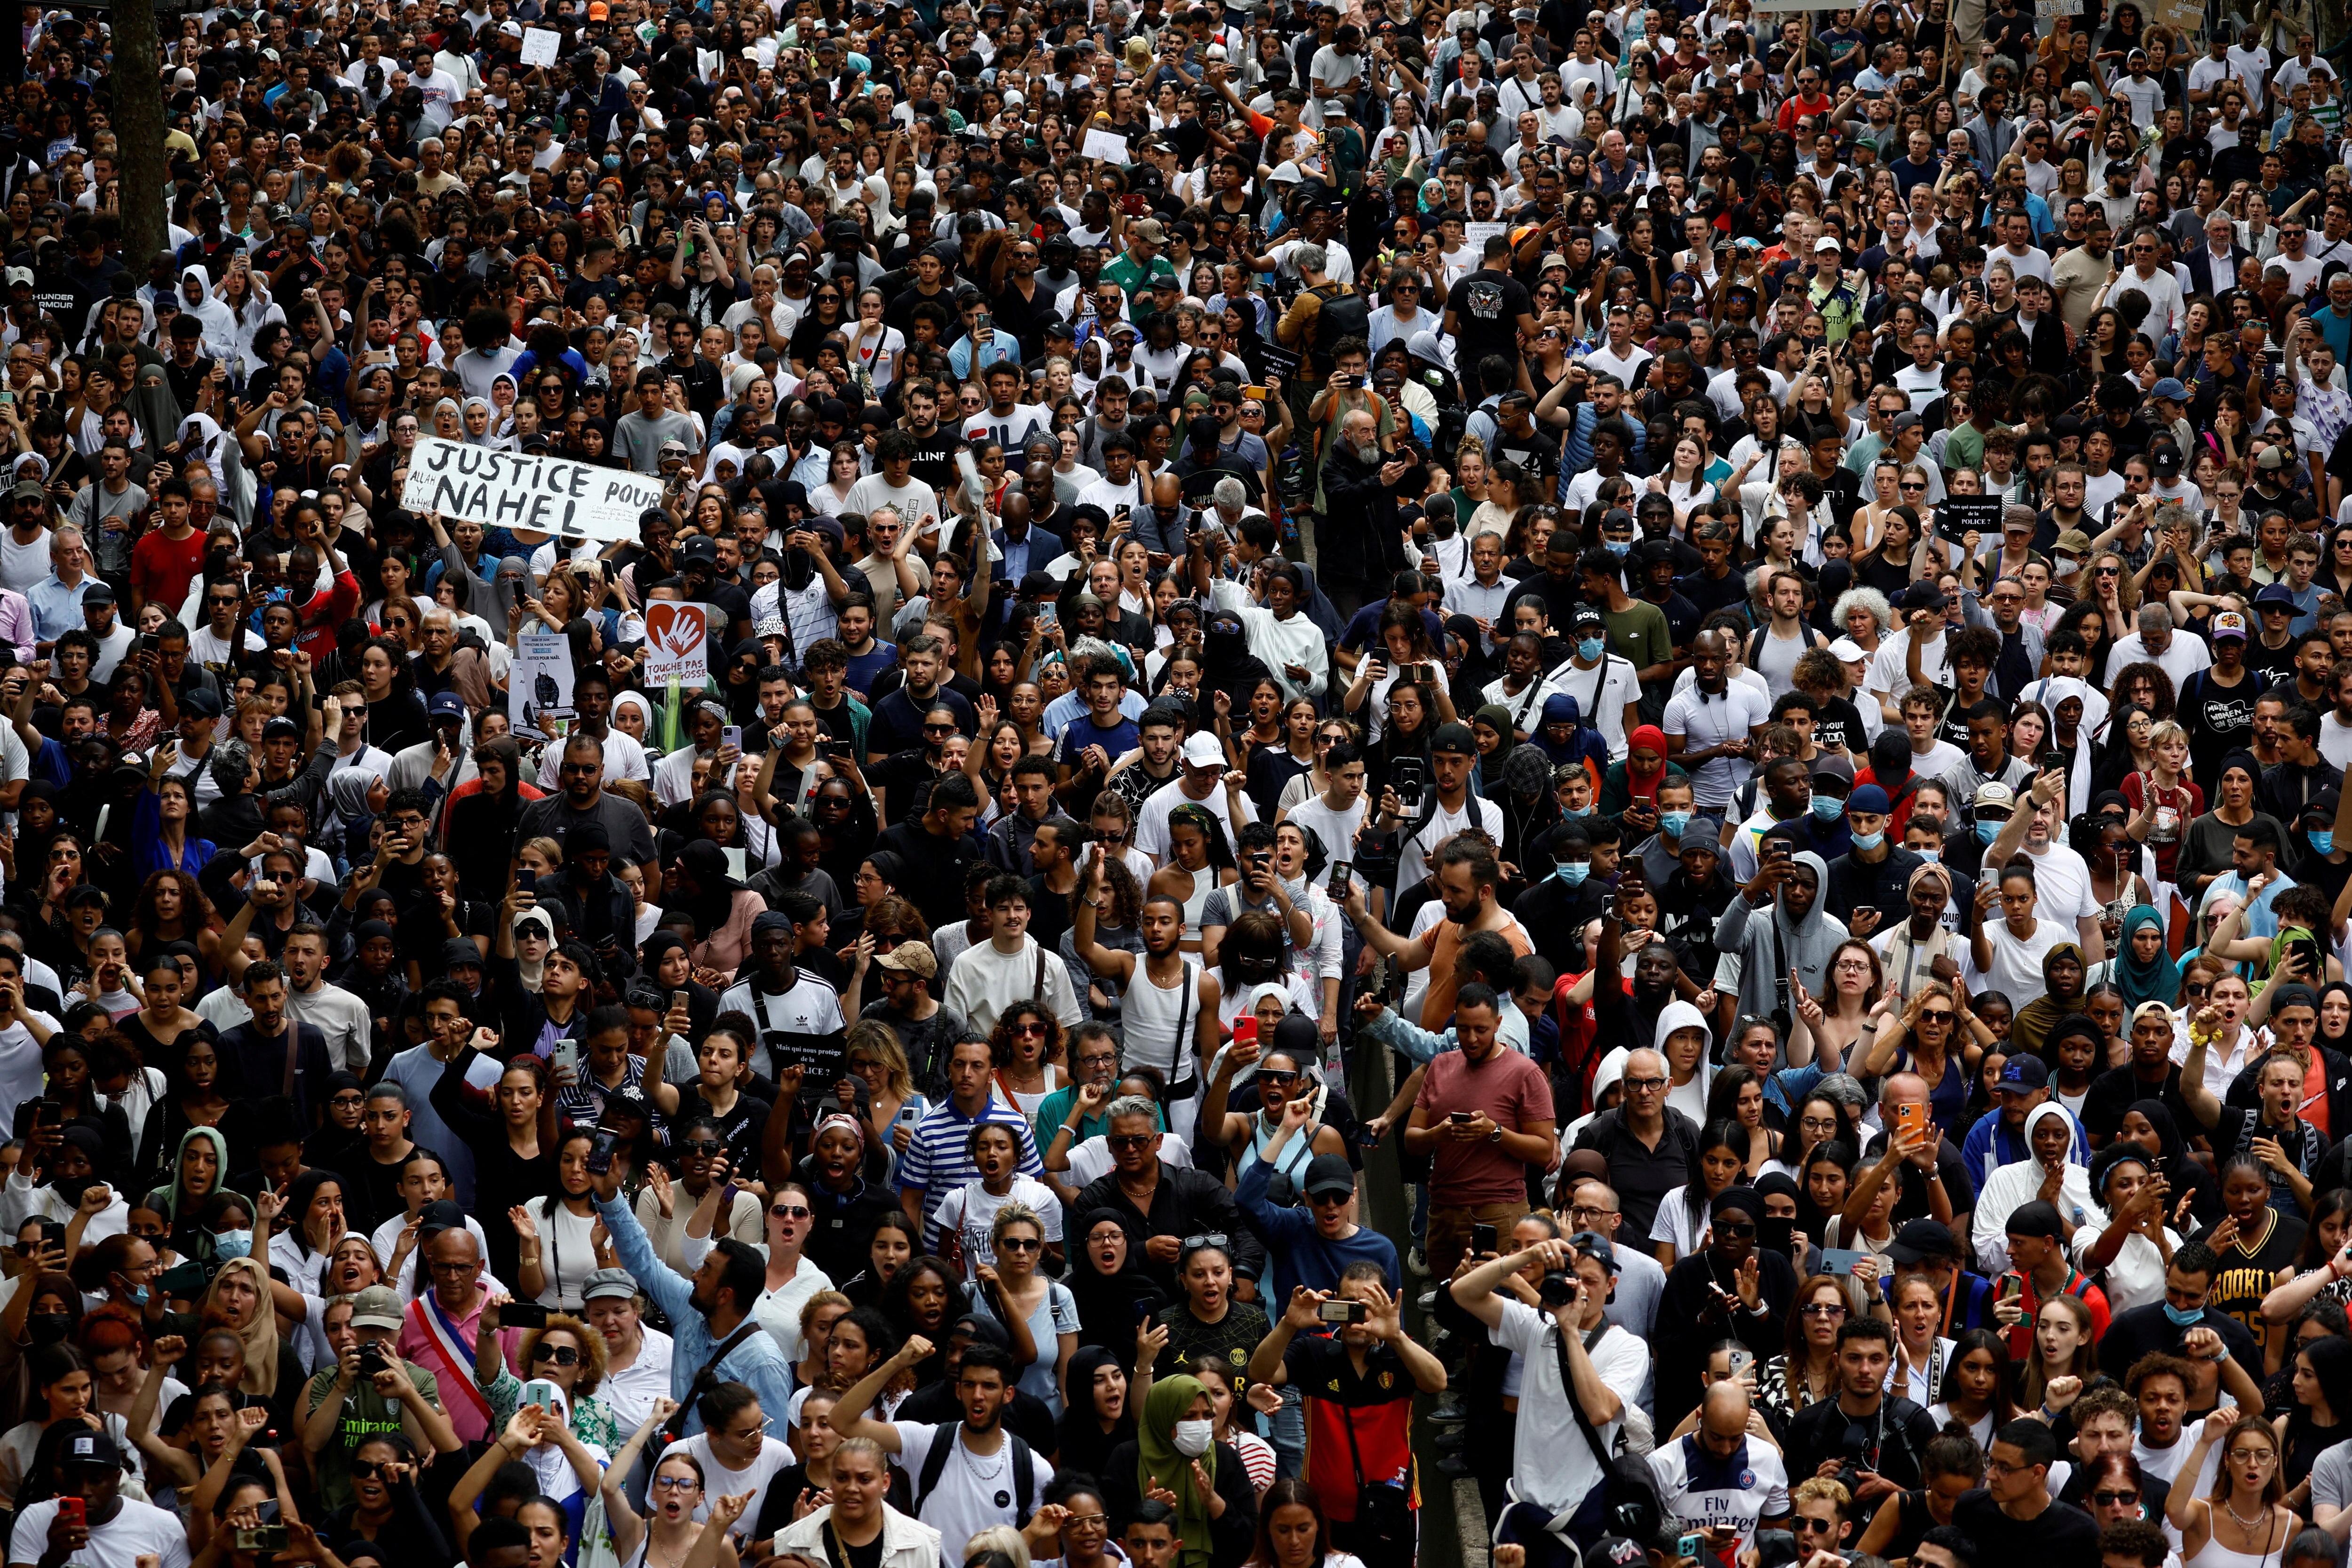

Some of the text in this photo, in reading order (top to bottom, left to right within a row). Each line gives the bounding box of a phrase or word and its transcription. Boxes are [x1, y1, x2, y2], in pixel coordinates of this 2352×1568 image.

[2168, 9, 2182, 18] TUE
[1149, 177, 1156, 185] NY
[1826, 315, 1845, 325] OTOP
[1265, 366, 1284, 376] POLICE
[2160, 454, 2168, 464] NY
[410, 470, 436, 485] ALLAH
[417, 486, 423, 496] Y
[604, 481, 662, 509] POUR
[432, 475, 585, 534] NAHEL
[1577, 612, 1600, 622] BOSS
[647, 660, 703, 675] TOUCHE PAS
[645, 674, 651, 686] À
[680, 669, 707, 681] GOSSE
[2210, 709, 2241, 721] WOMEN
[2227, 714, 2251, 728] STAGE
[1942, 913, 1960, 923] OUR
[1803, 966, 1816, 975] PUMA
[818, 1049, 842, 1057] protège
[803, 1067, 823, 1075] LICE
[2004, 1062, 2022, 1082] LA
[727, 1118, 749, 1141] protège
[966, 1227, 991, 1254] JUSTI
[339, 1416, 402, 1434] Emirates
[344, 1433, 359, 1447] FLY
[1705, 1496, 1729, 1514] Fly
